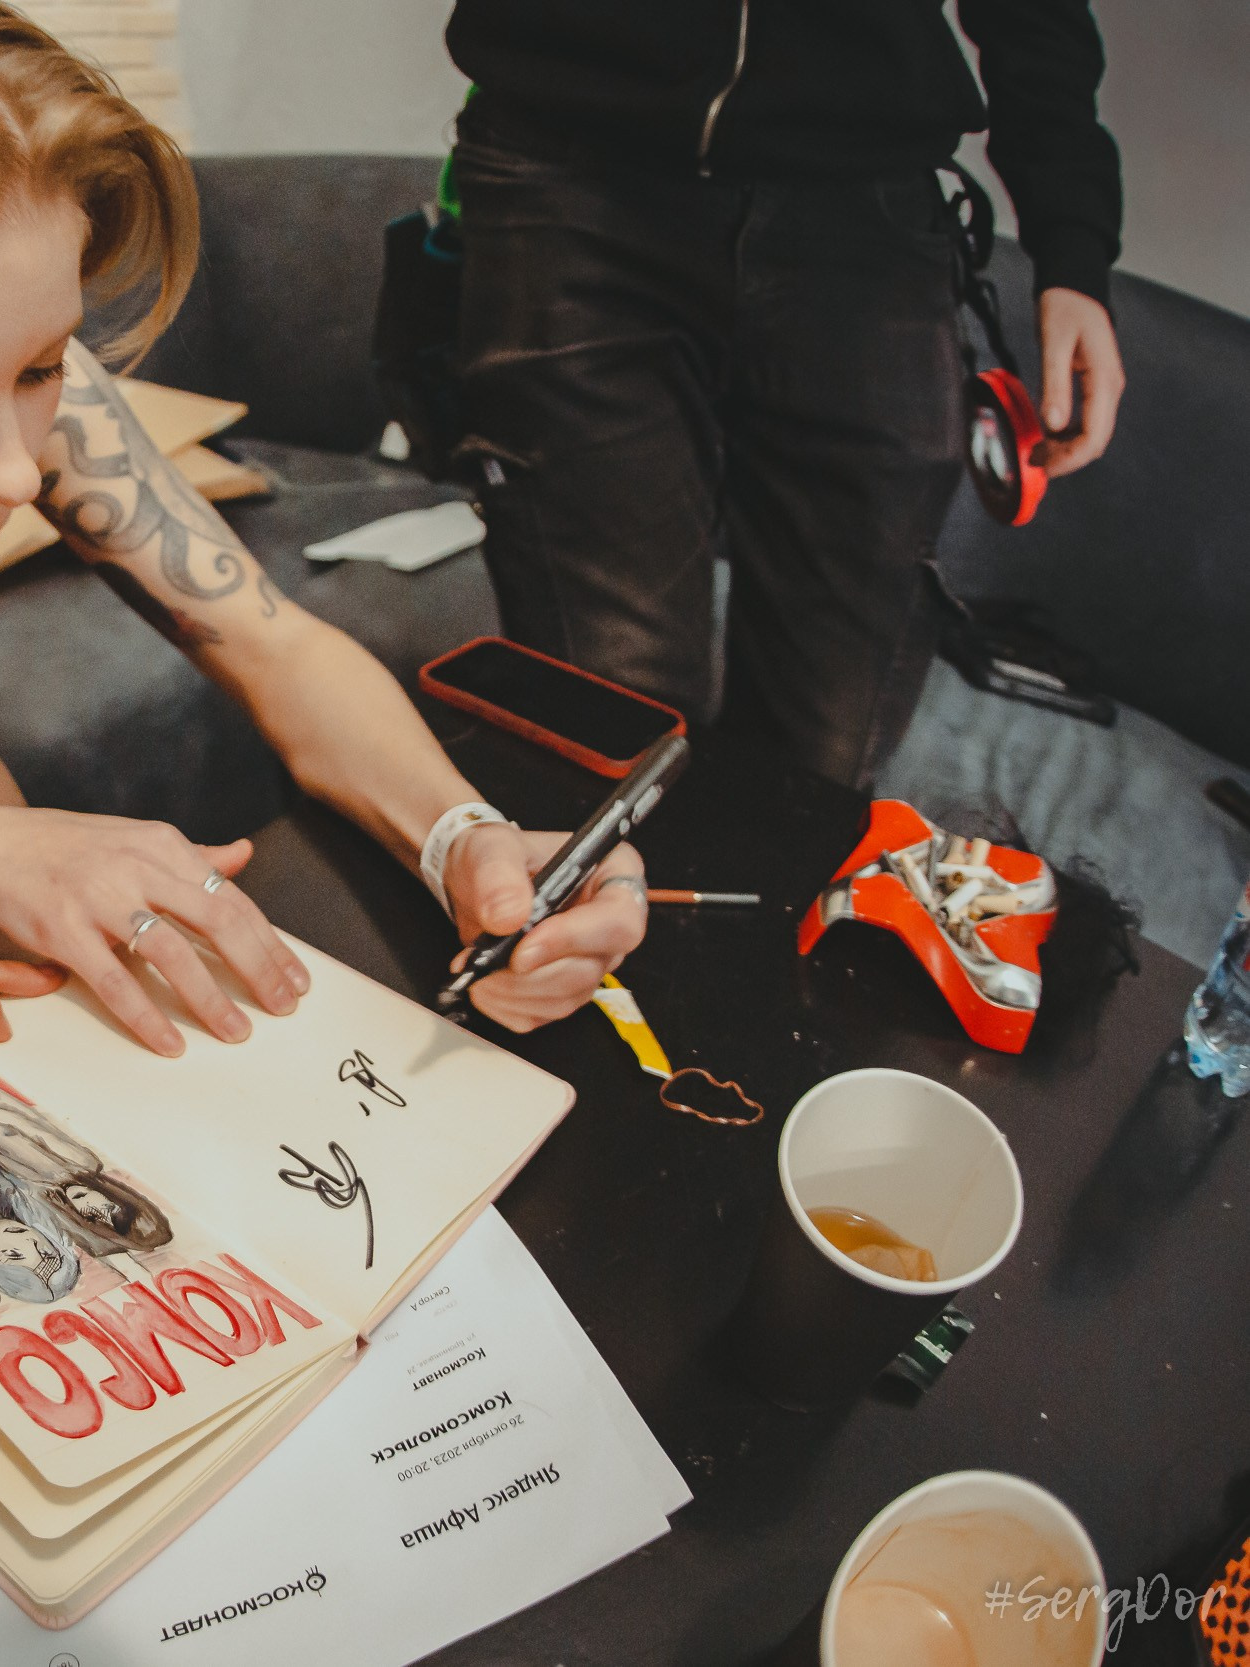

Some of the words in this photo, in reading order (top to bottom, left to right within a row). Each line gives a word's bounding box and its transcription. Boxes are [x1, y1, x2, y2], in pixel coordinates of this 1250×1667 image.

[419, 1285, 451, 1307] Сектор
[412, 1347, 487, 1392] Космонавт
[370, 1390, 513, 1464] Комсомольск
[462, 1421, 508, 1451] октября
[509, 1413, 525, 1428] 26
[397, 1460, 431, 1483] 20:00
[429, 1445, 463, 1466] 2023,
[482, 1462, 561, 1511] Яндекс
[400, 1502, 481, 1549] Афиша
[160, 1580, 305, 1643] КОСМОНАВТ
